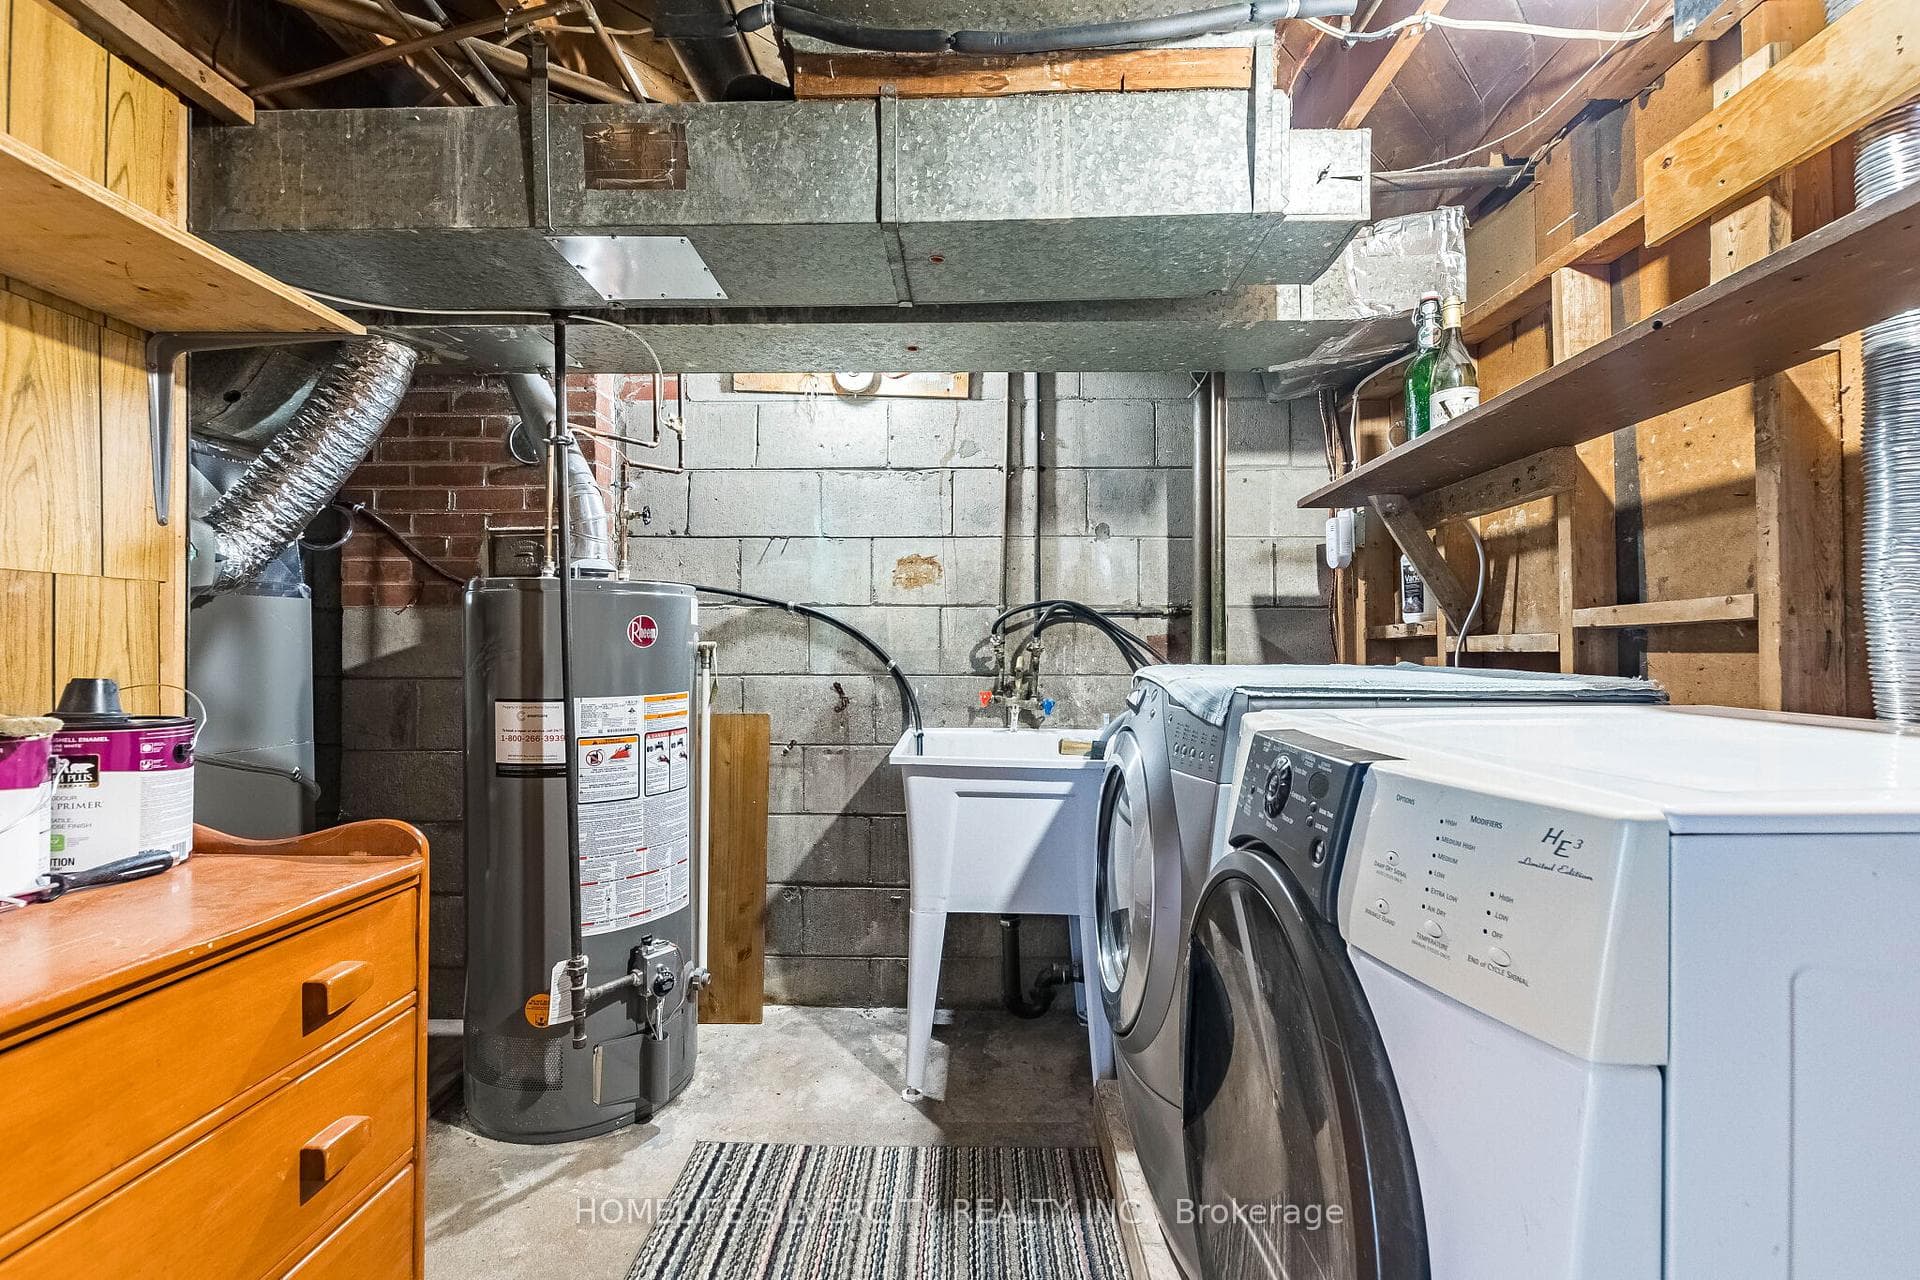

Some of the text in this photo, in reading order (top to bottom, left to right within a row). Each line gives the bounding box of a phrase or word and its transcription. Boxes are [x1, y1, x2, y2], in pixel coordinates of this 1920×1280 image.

[631, 616, 656, 642] Rheem
[67, 773, 93, 783] PLUS
[57, 801, 103, 810] PRIMER
[1518, 857, 1593, 881] Limited Edition
